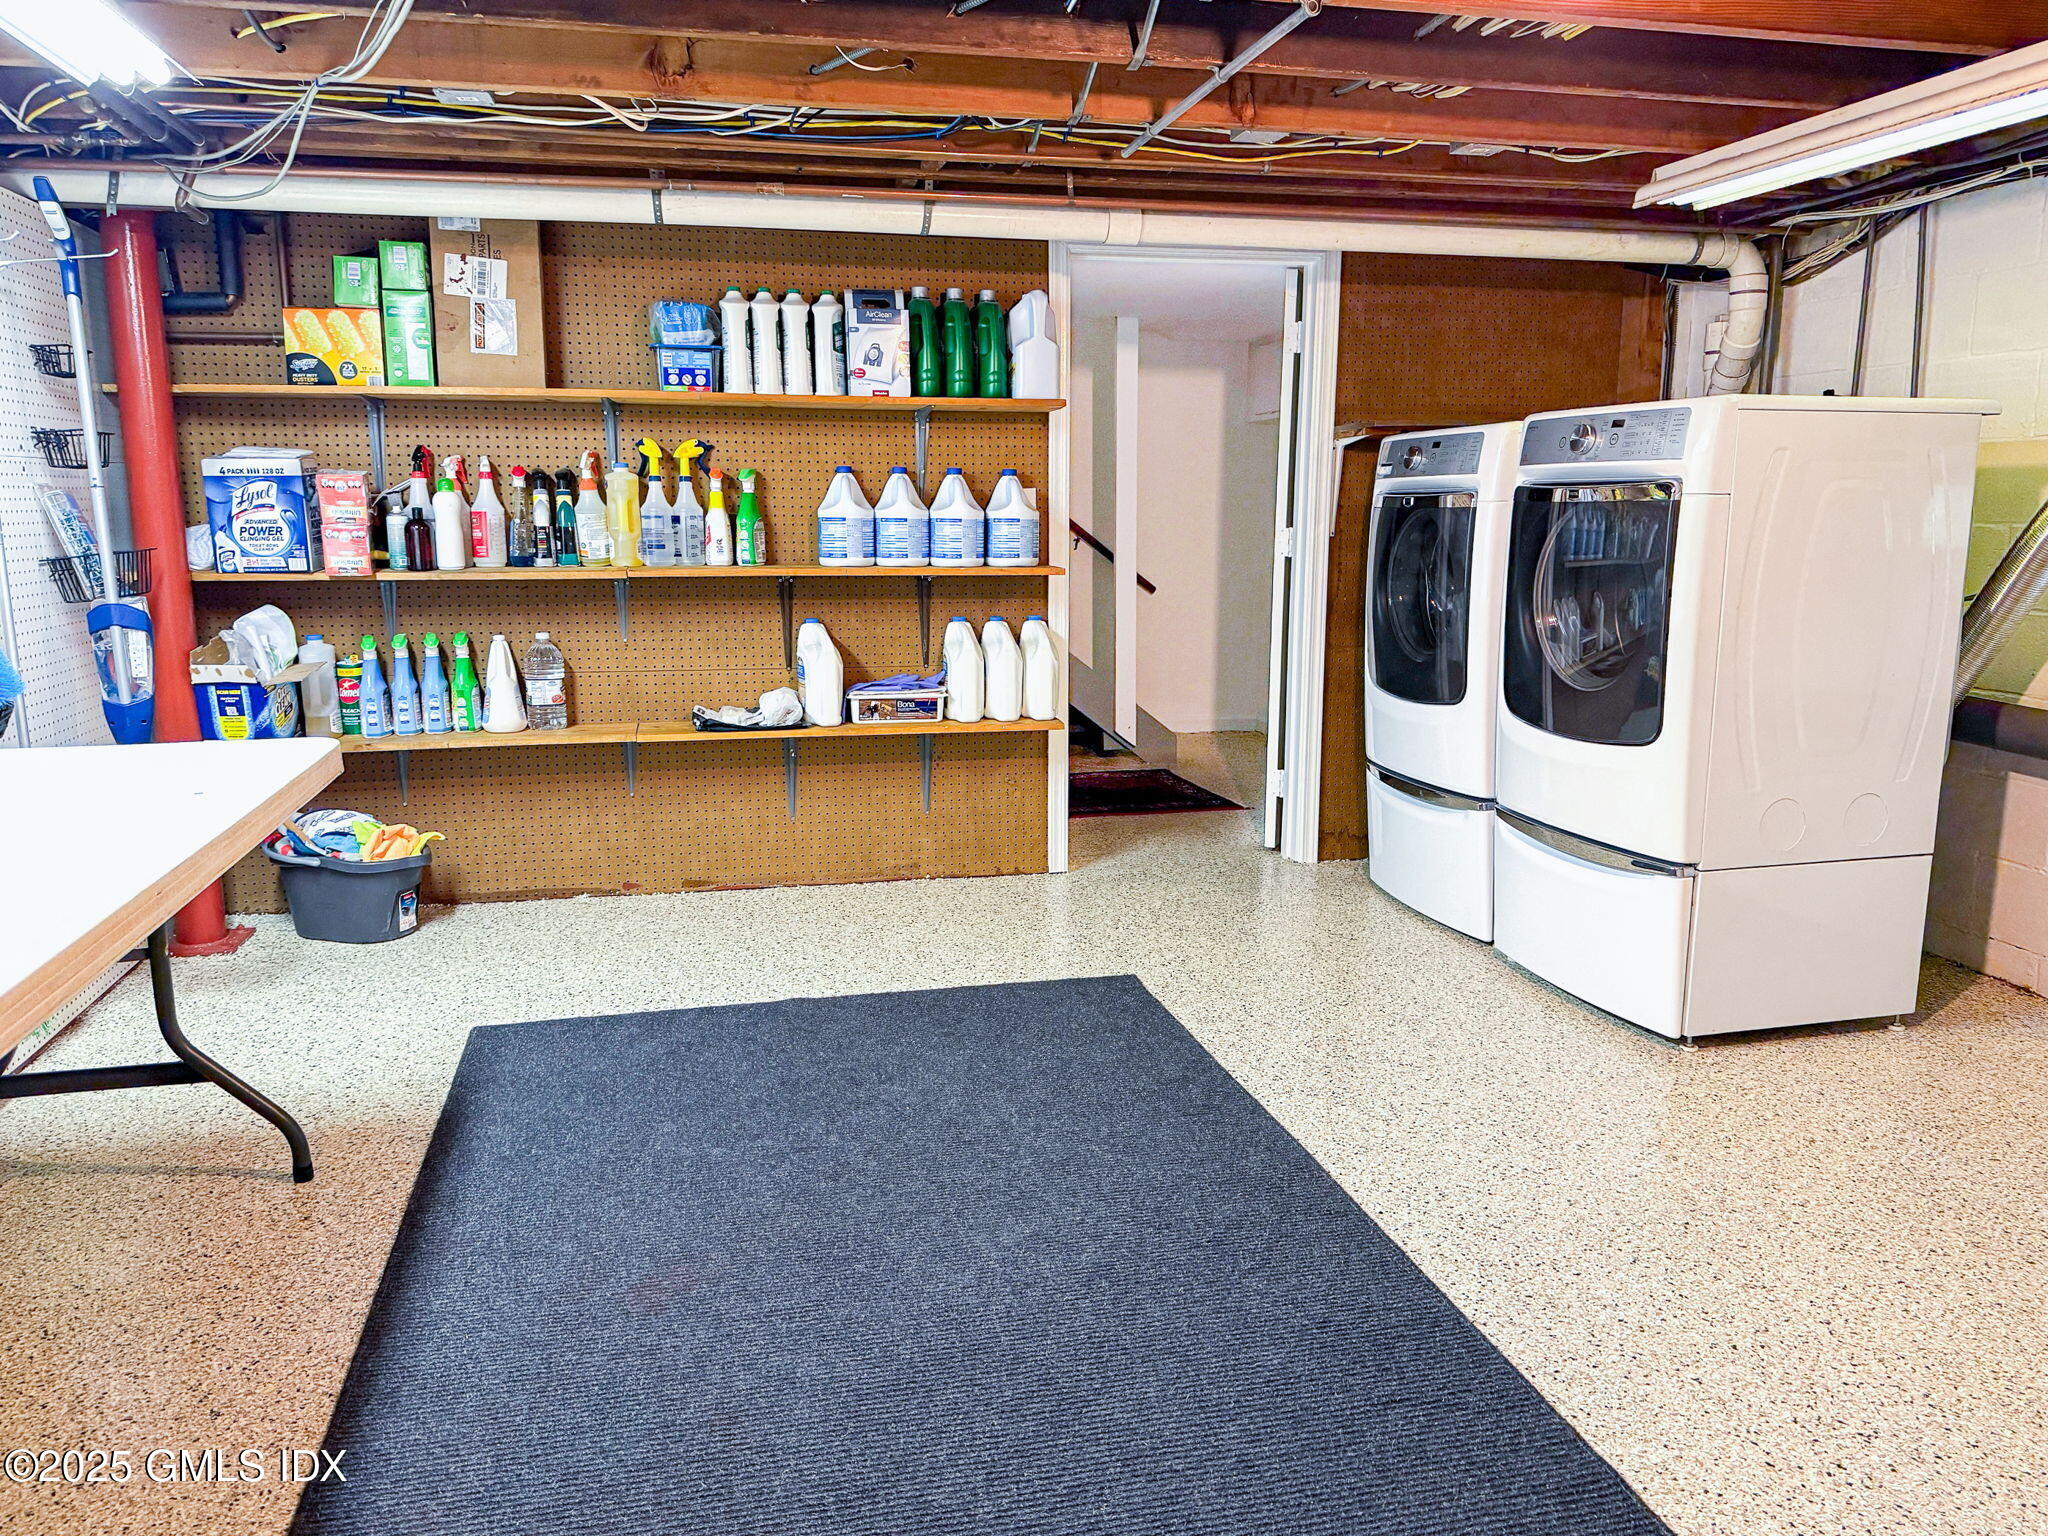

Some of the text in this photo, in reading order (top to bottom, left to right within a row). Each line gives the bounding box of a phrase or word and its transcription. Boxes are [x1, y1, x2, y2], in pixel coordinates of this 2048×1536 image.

[477, 233, 486, 259] PARTS
[865, 310, 893, 318] AirClean
[219, 466, 226, 475] 4
[262, 467, 274, 475] 128
[275, 467, 285, 475] OZ
[235, 483, 274, 509] Lysol
[240, 526, 283, 536] POWER
[897, 700, 915, 708] Bona
